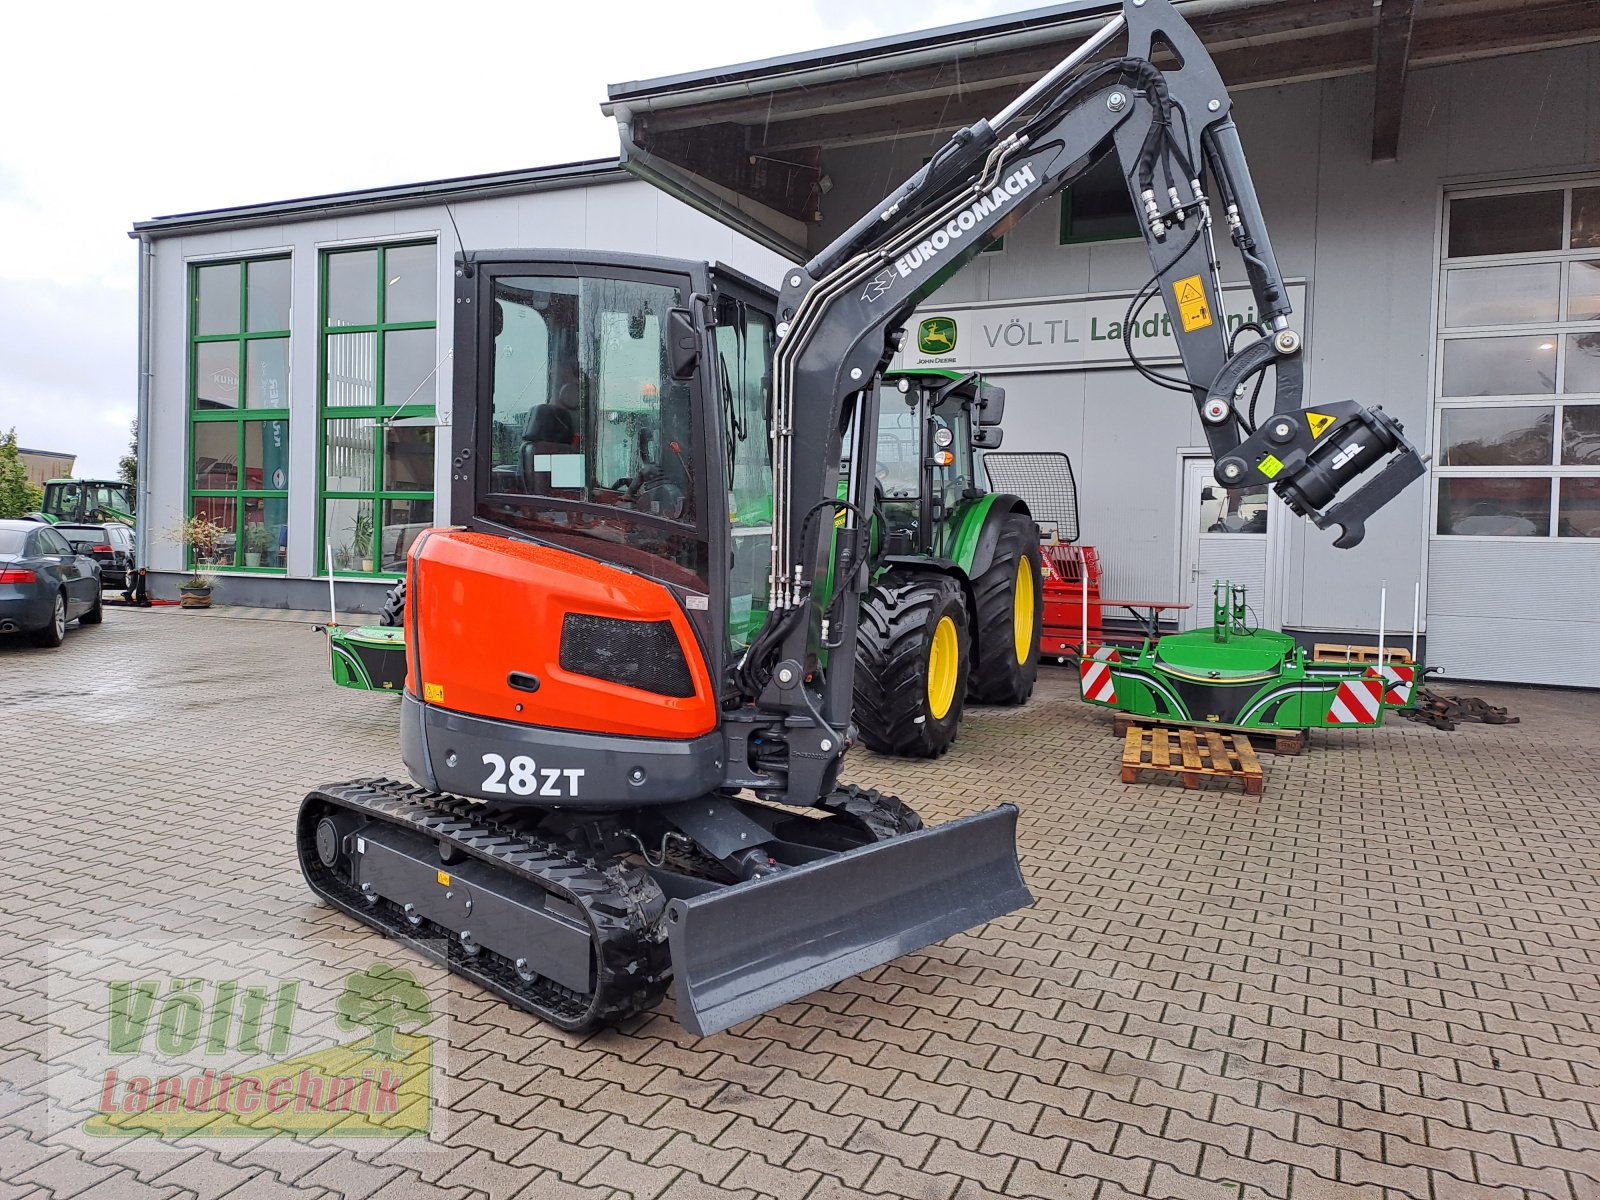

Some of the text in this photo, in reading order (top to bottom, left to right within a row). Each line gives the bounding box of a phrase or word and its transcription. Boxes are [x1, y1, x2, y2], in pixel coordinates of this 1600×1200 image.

[895, 164, 1036, 278] EUROCOMACH
[983, 318, 1079, 348] VÖLTL
[481, 753, 585, 796] 28ZT
